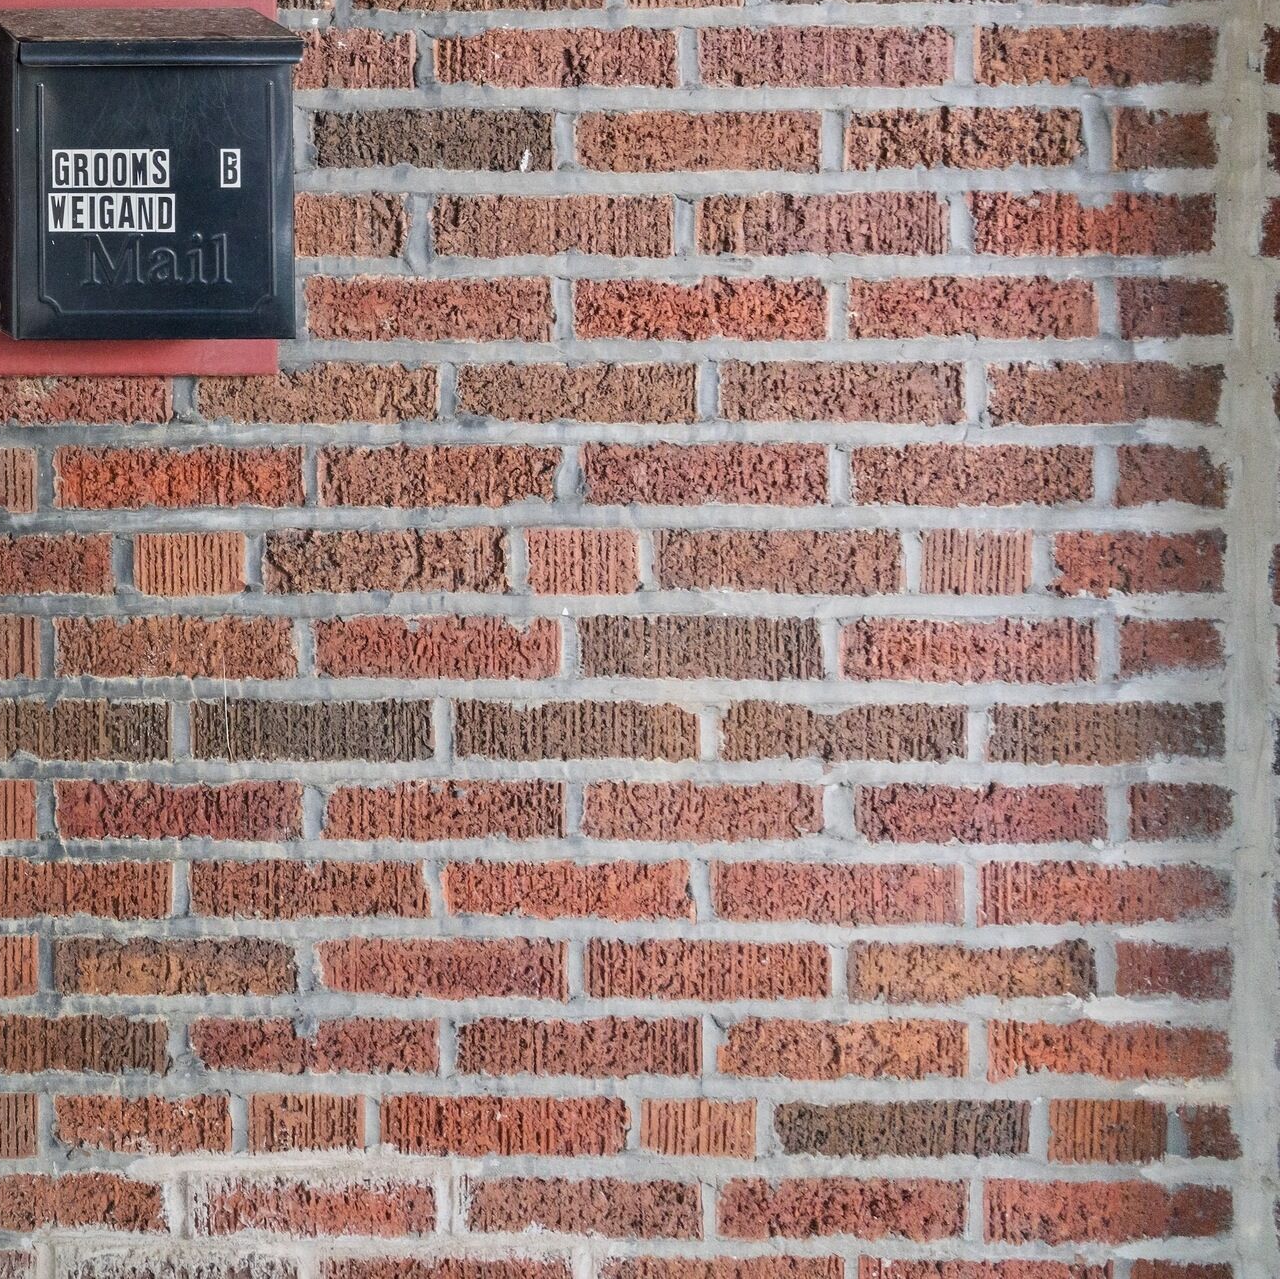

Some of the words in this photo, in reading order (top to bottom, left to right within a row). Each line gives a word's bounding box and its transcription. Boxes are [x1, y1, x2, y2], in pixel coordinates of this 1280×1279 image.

[54, 150, 167, 186] GROOMS
[223, 151, 238, 184] B
[51, 195, 173, 230] WEIGAND
[80, 232, 233, 285] Mail
